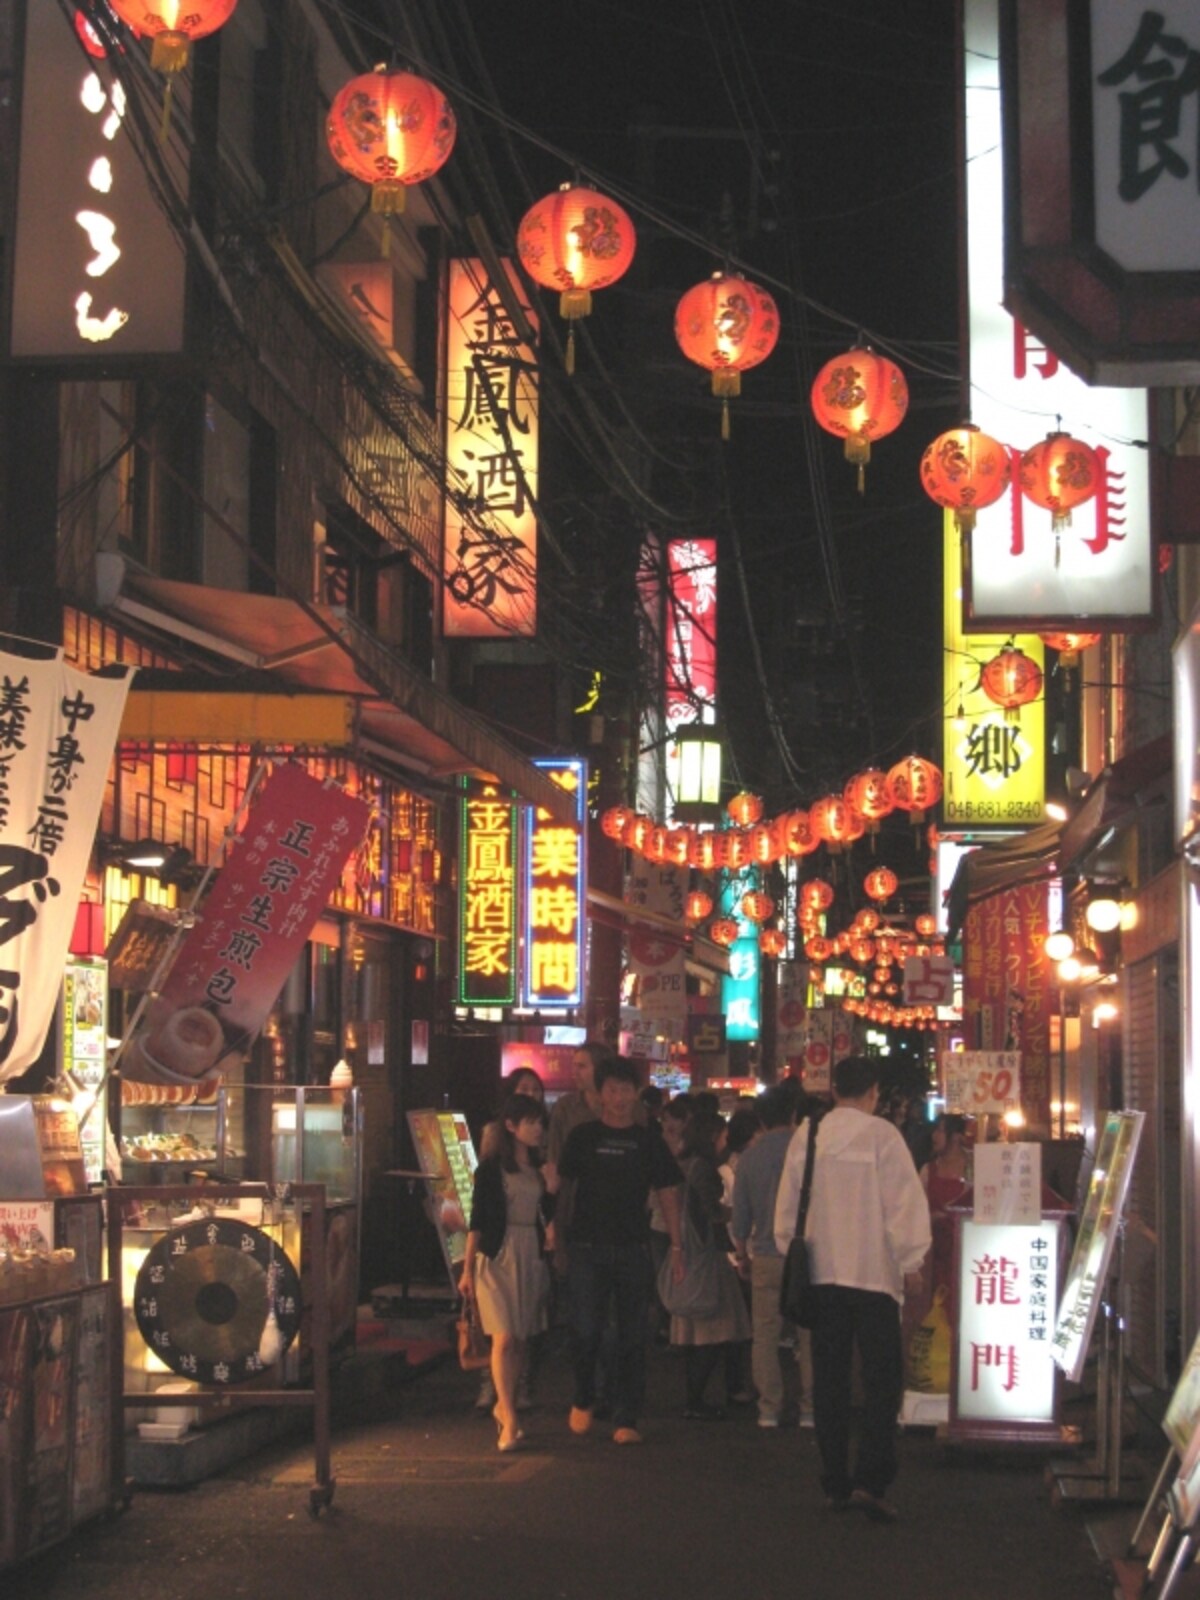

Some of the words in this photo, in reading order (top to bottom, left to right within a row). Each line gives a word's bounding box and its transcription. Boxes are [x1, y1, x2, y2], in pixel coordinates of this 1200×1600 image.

[454, 281, 532, 608] 金鳳酒家
[465, 786, 512, 976] 金鳳酒家
[531, 768, 579, 991] 業時間
[947, 801, 1041, 818] 045-681-2340
[205, 820, 315, 1006] 正宗生煎包
[908, 959, 952, 1002] 占
[970, 1253, 1021, 1392] 龍門
[1028, 1237, 1048, 1341] 中国家庭料理
